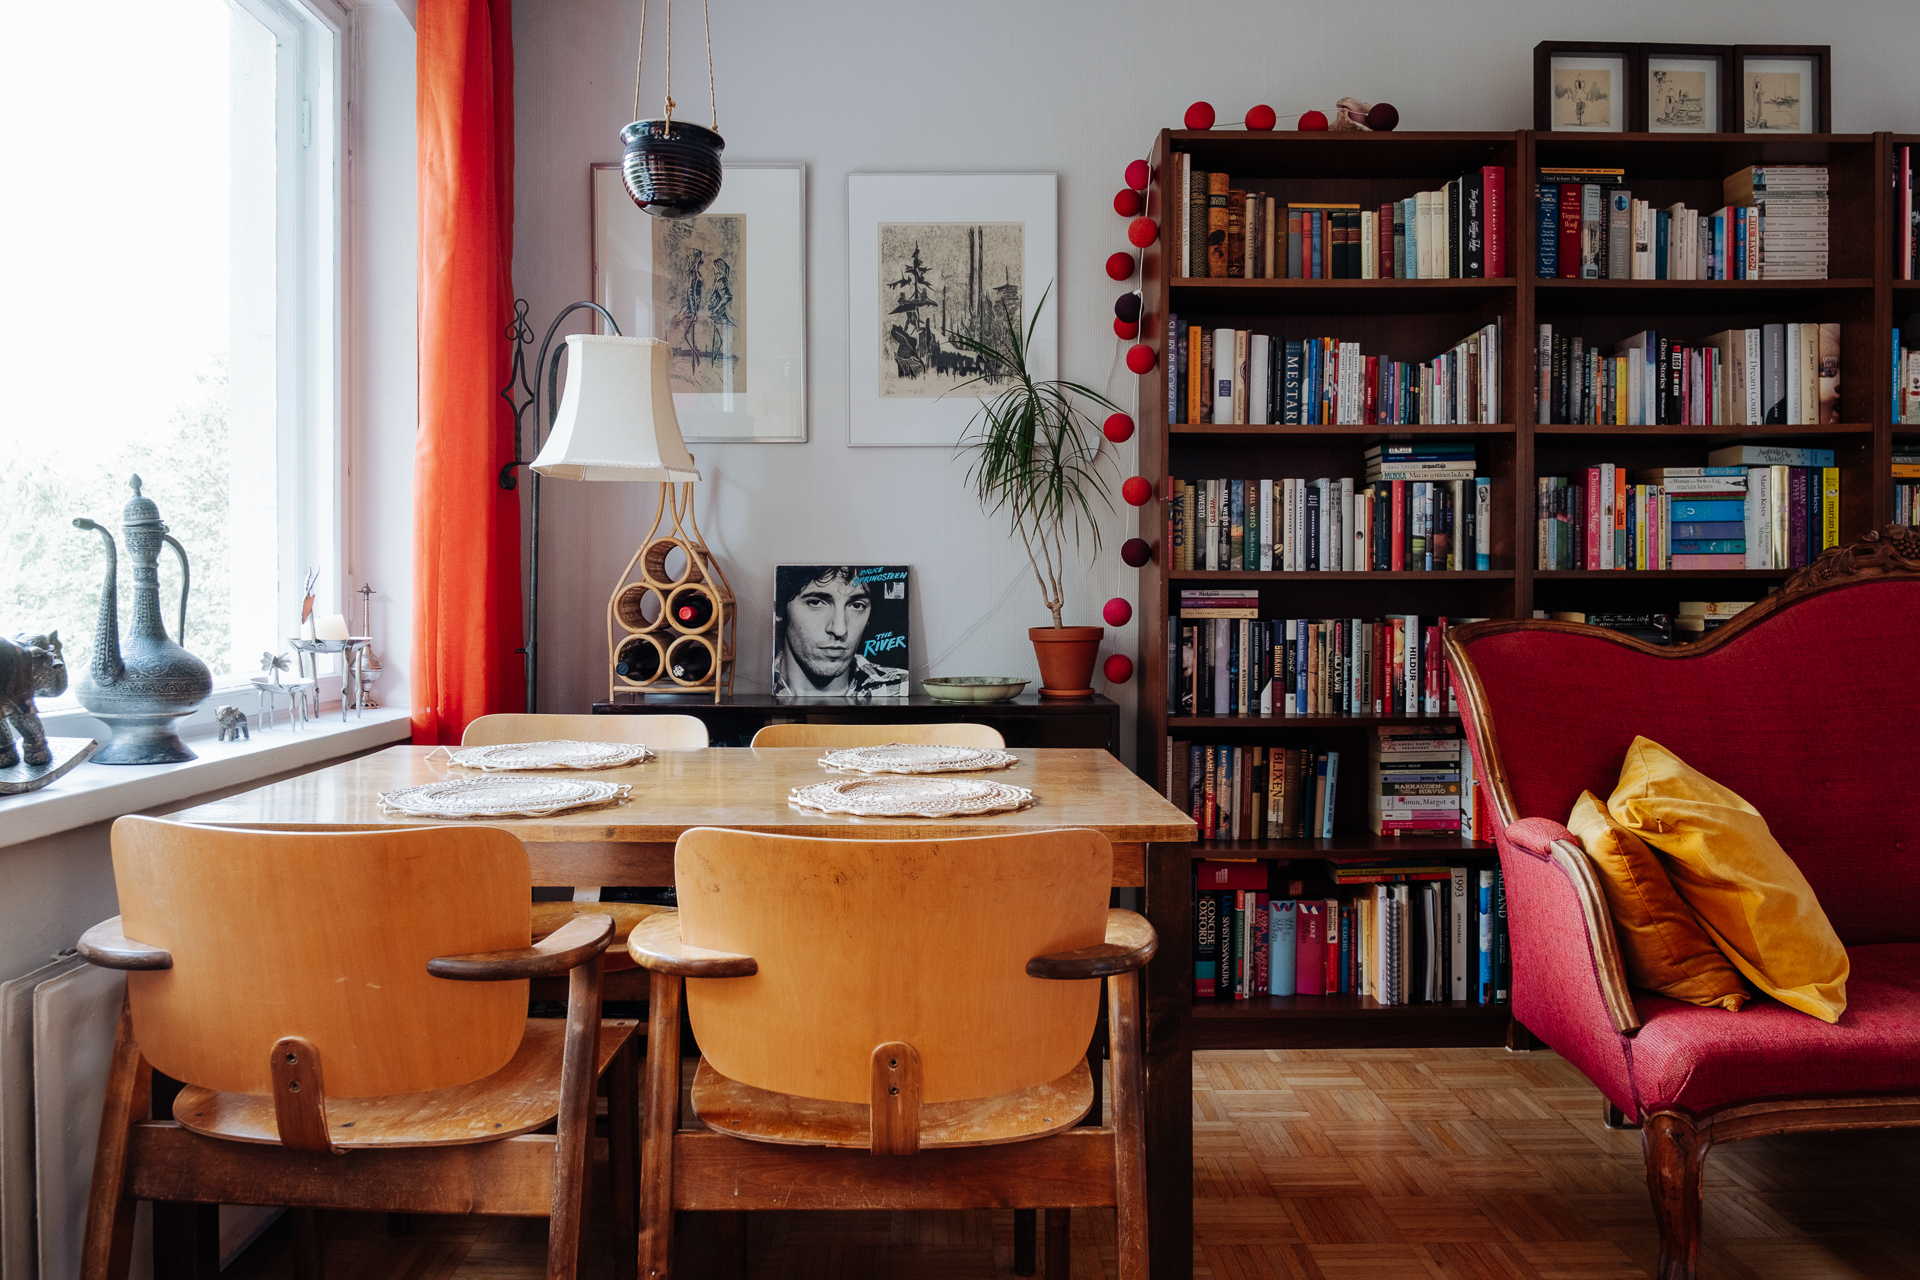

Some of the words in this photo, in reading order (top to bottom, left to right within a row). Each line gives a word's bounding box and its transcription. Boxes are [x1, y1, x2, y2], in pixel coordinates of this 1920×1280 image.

[1749, 216, 1757, 234] BILL
[1749, 236, 1757, 270] BRYSON
[1542, 335, 1550, 347] PAUL
[1542, 348, 1550, 367] AUSTER
[1672, 352, 1682, 370] LOGO
[1750, 361, 1758, 390] Dream
[1750, 391, 1758, 418] Count
[1589, 472, 1599, 506] Christmas
[1792, 479, 1800, 501] KEYES
[1812, 474, 1820, 496] marian
[1198, 494, 1206, 518] WESTÖ
[1812, 496, 1820, 514] keyes
[1828, 501, 1836, 529] marian
[1173, 494, 1185, 547] WESTÖ
[1589, 506, 1599, 534] Magic
[851, 572, 908, 587] SPRINGSTEEN
[860, 567, 884, 576] BRUCE
[863, 635, 907, 657] RIVER
[875, 631, 893, 640] THE
[1274, 645, 1283, 679] SANKARIT
[1409, 646, 1417, 681] HILDUR
[1207, 748, 1215, 772] KAARI
[1207, 773, 1215, 798] UTRIO
[1270, 752, 1284, 797] BLIXEN
[1401, 797, 1422, 805] Sinun,
[1422, 799, 1447, 807] Margot
[1454, 874, 1464, 898] 1993
[1222, 895, 1232, 916] UUSI
[1198, 900, 1208, 945] OXFORD
[1207, 900, 1216, 945] CONCISE
[1221, 916, 1230, 988] SIVISTYSSANAKIRJA
